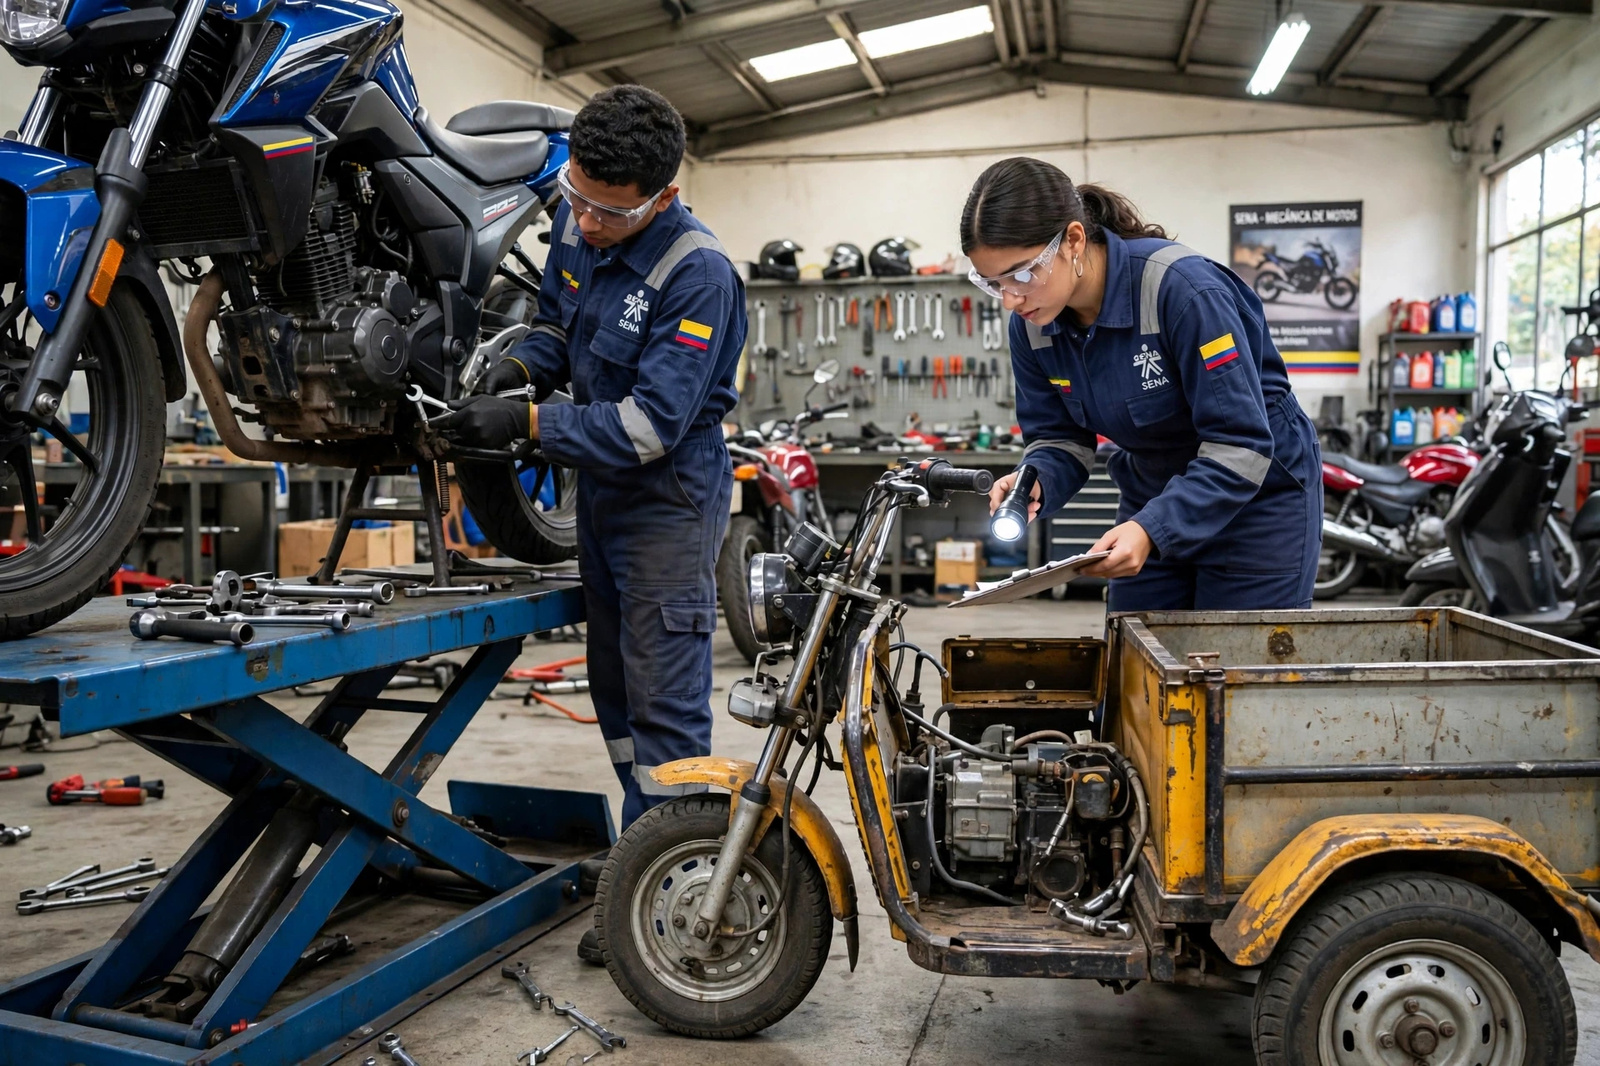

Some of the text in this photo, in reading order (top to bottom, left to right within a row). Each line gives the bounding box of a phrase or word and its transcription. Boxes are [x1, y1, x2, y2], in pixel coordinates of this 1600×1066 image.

[1234, 211, 1259, 225] SENA
[618, 319, 640, 334] SENA
[1141, 376, 1170, 390] SENA
